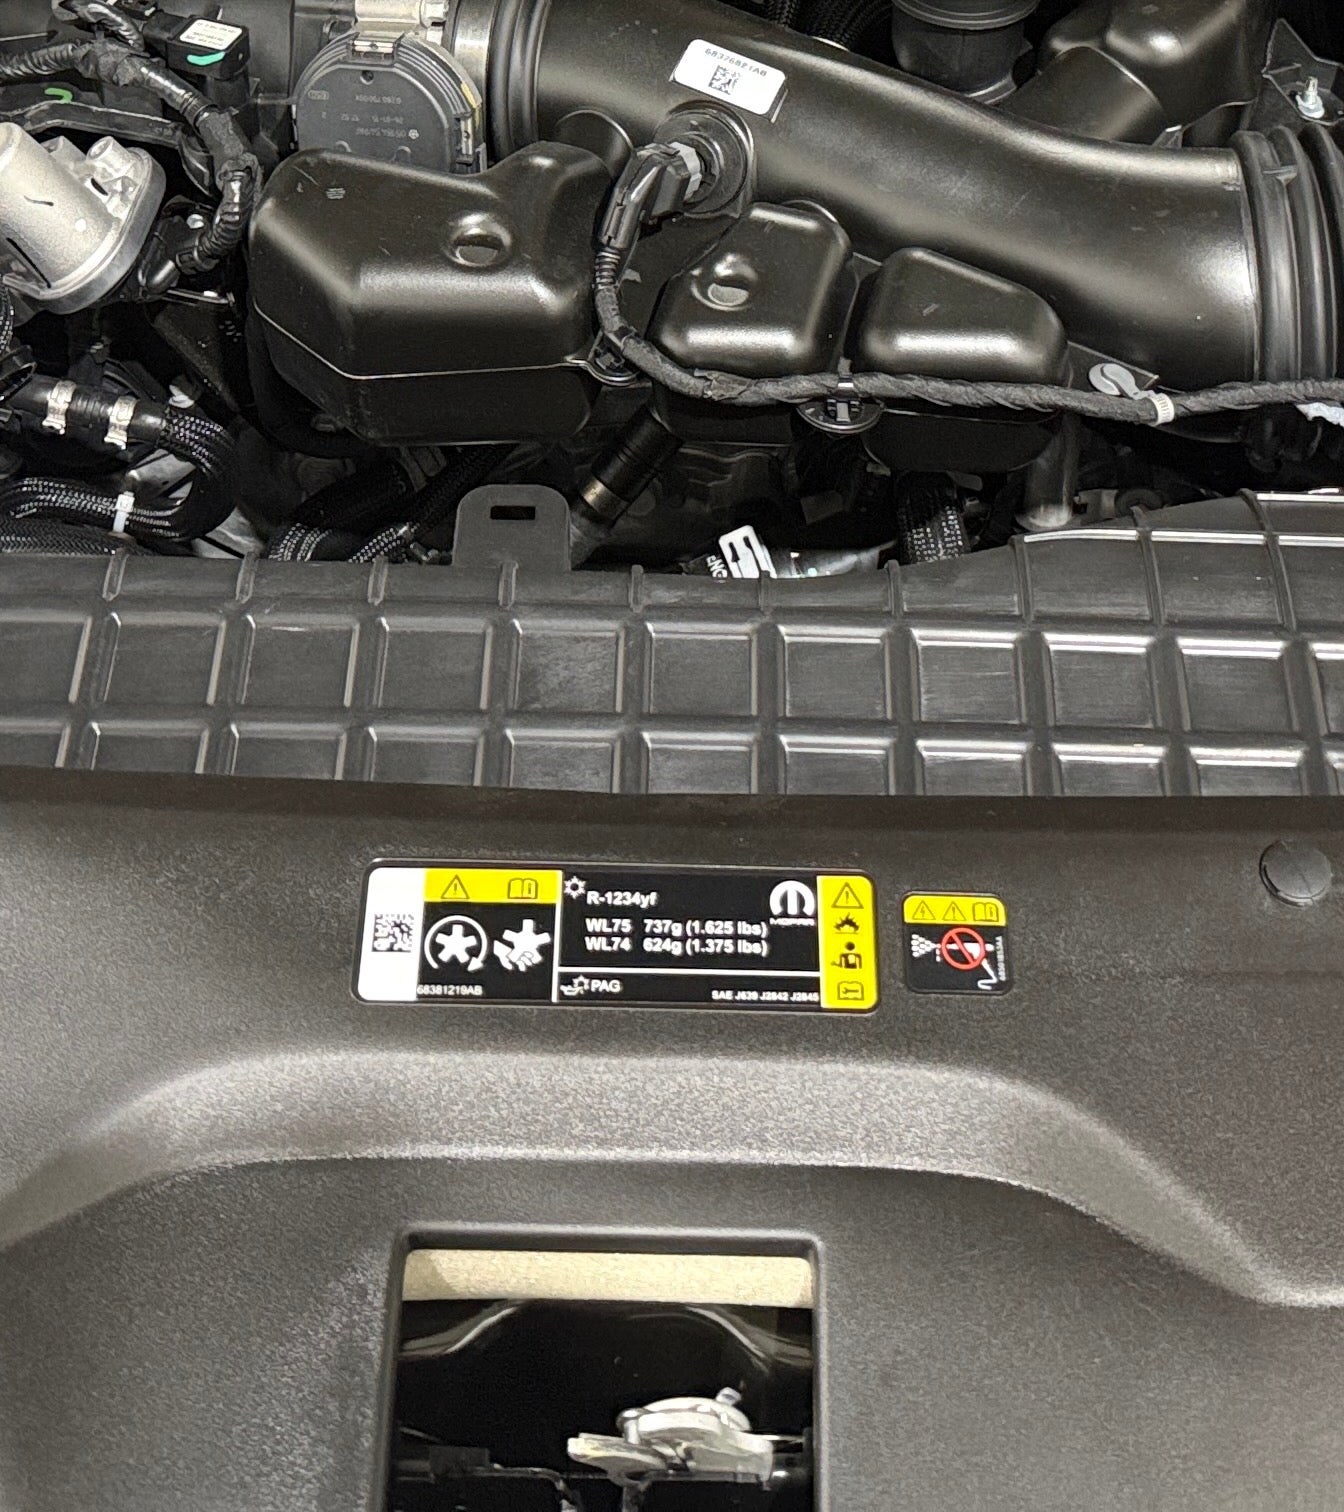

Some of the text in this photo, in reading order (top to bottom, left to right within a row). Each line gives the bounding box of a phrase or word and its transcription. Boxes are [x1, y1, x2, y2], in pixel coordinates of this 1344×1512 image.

[586, 890, 657, 908] R-1234yf
[585, 918, 768, 938] WL75 737g (1.625 lbs)
[585, 936, 768, 957] WL74 624g (1.375 lbs)
[591, 979, 620, 993] PAG
[712, 990, 733, 1000] SAE
